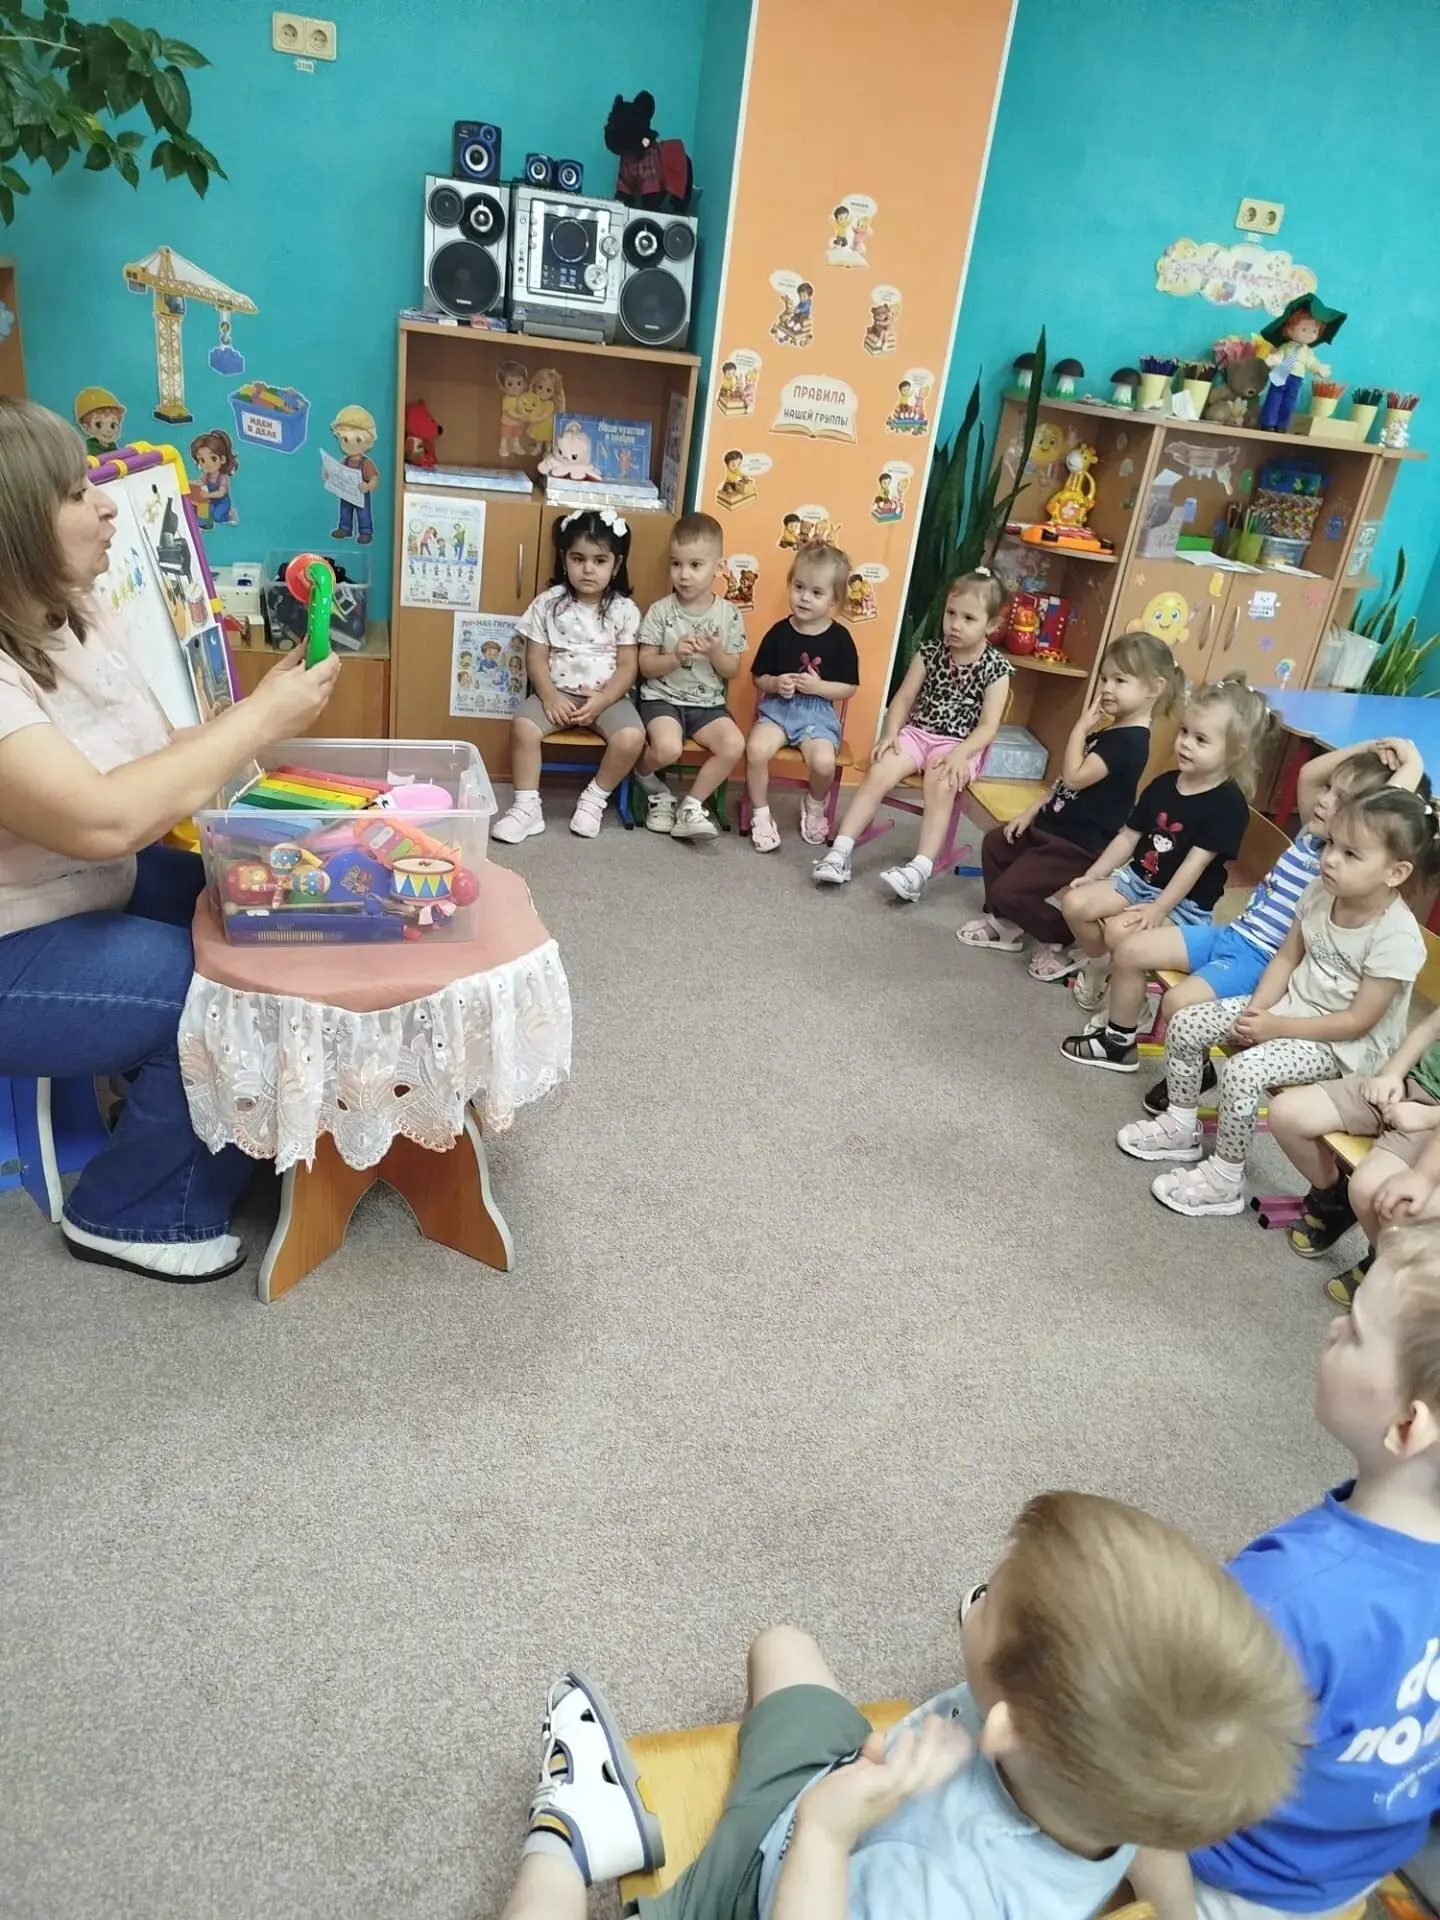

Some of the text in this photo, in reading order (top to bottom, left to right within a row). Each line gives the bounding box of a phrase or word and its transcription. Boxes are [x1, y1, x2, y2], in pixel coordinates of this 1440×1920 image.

[793, 385, 846, 405] ПРАВИЛА
[783, 408, 849, 426] НАШЕЙ ГРУППЫ
[247, 424, 277, 438] В ДЕЛЕ
[493, 620, 516, 629] ГИГИЕ
